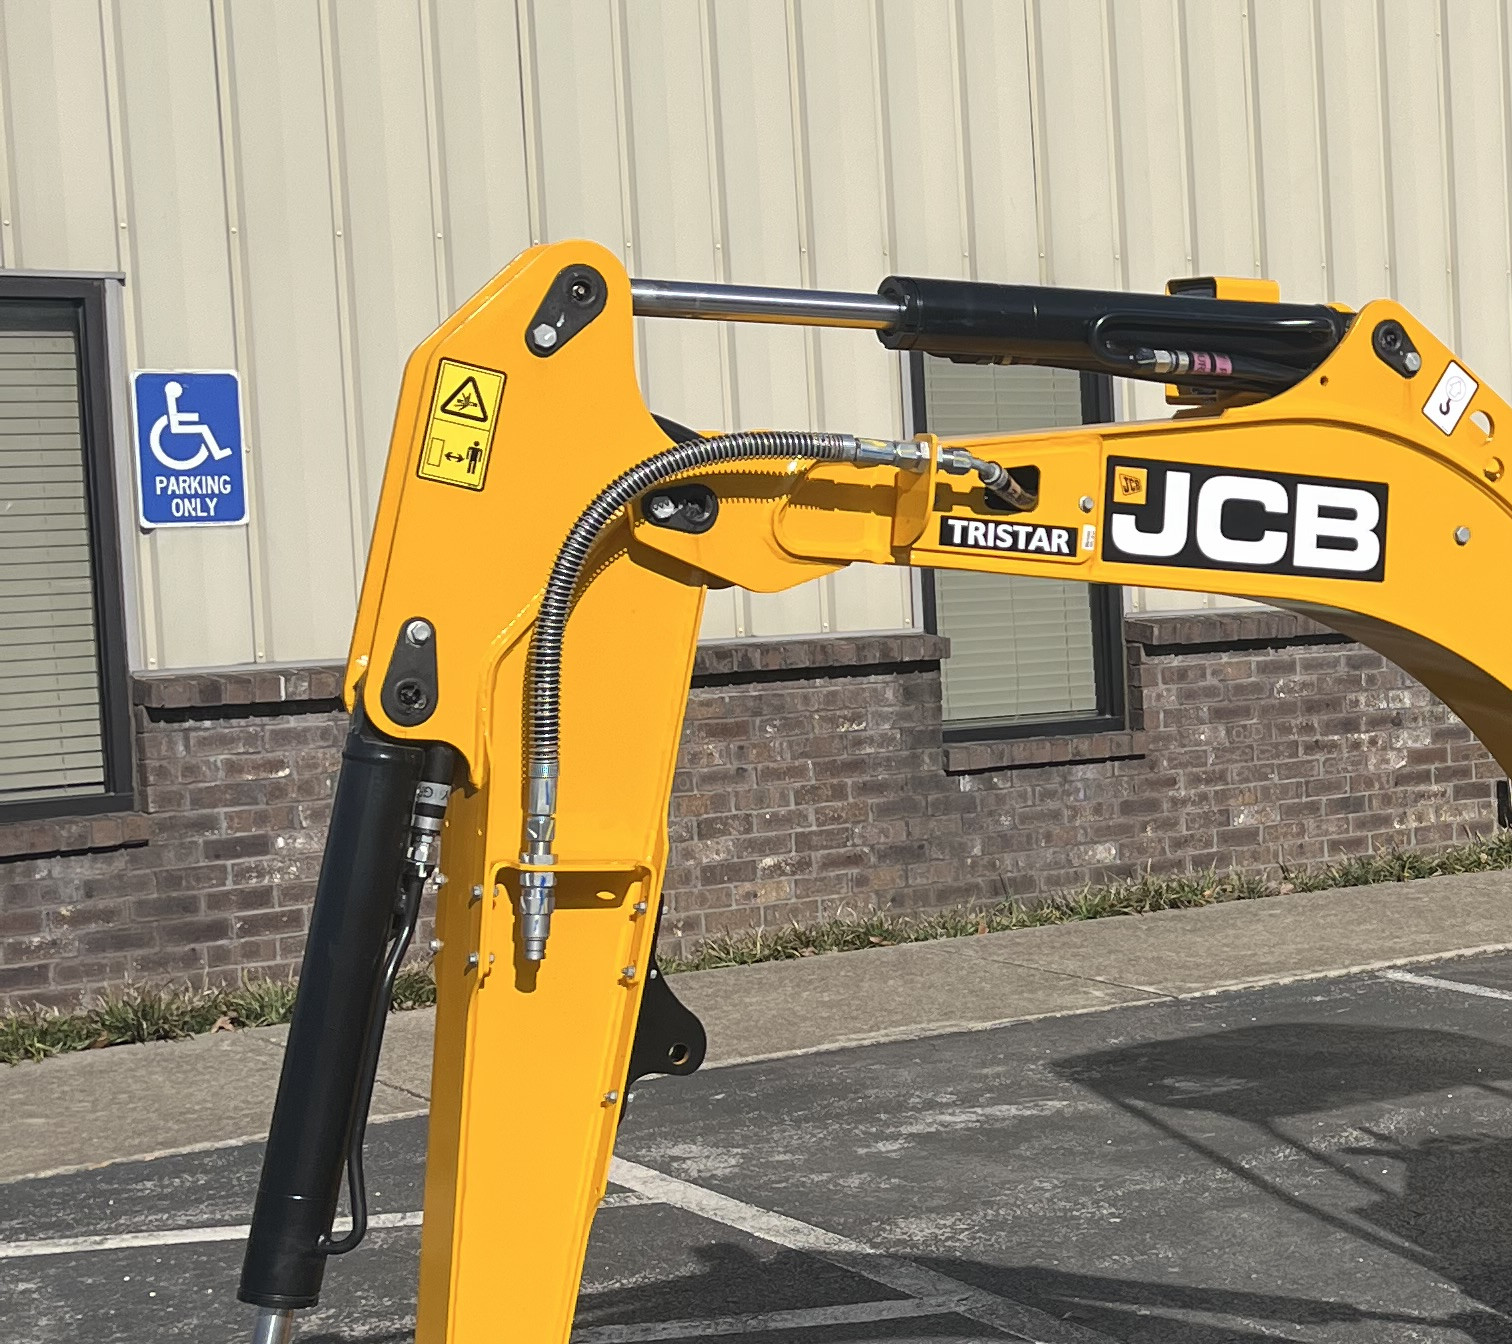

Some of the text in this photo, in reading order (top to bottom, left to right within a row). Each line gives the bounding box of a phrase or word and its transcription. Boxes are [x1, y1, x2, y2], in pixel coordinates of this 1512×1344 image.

[155, 475, 231, 495] PARKING
[1122, 476, 1142, 494] JCB
[171, 497, 218, 517] ONLY
[1111, 470, 1379, 572] JCB
[947, 518, 1070, 554] TRISTAR
